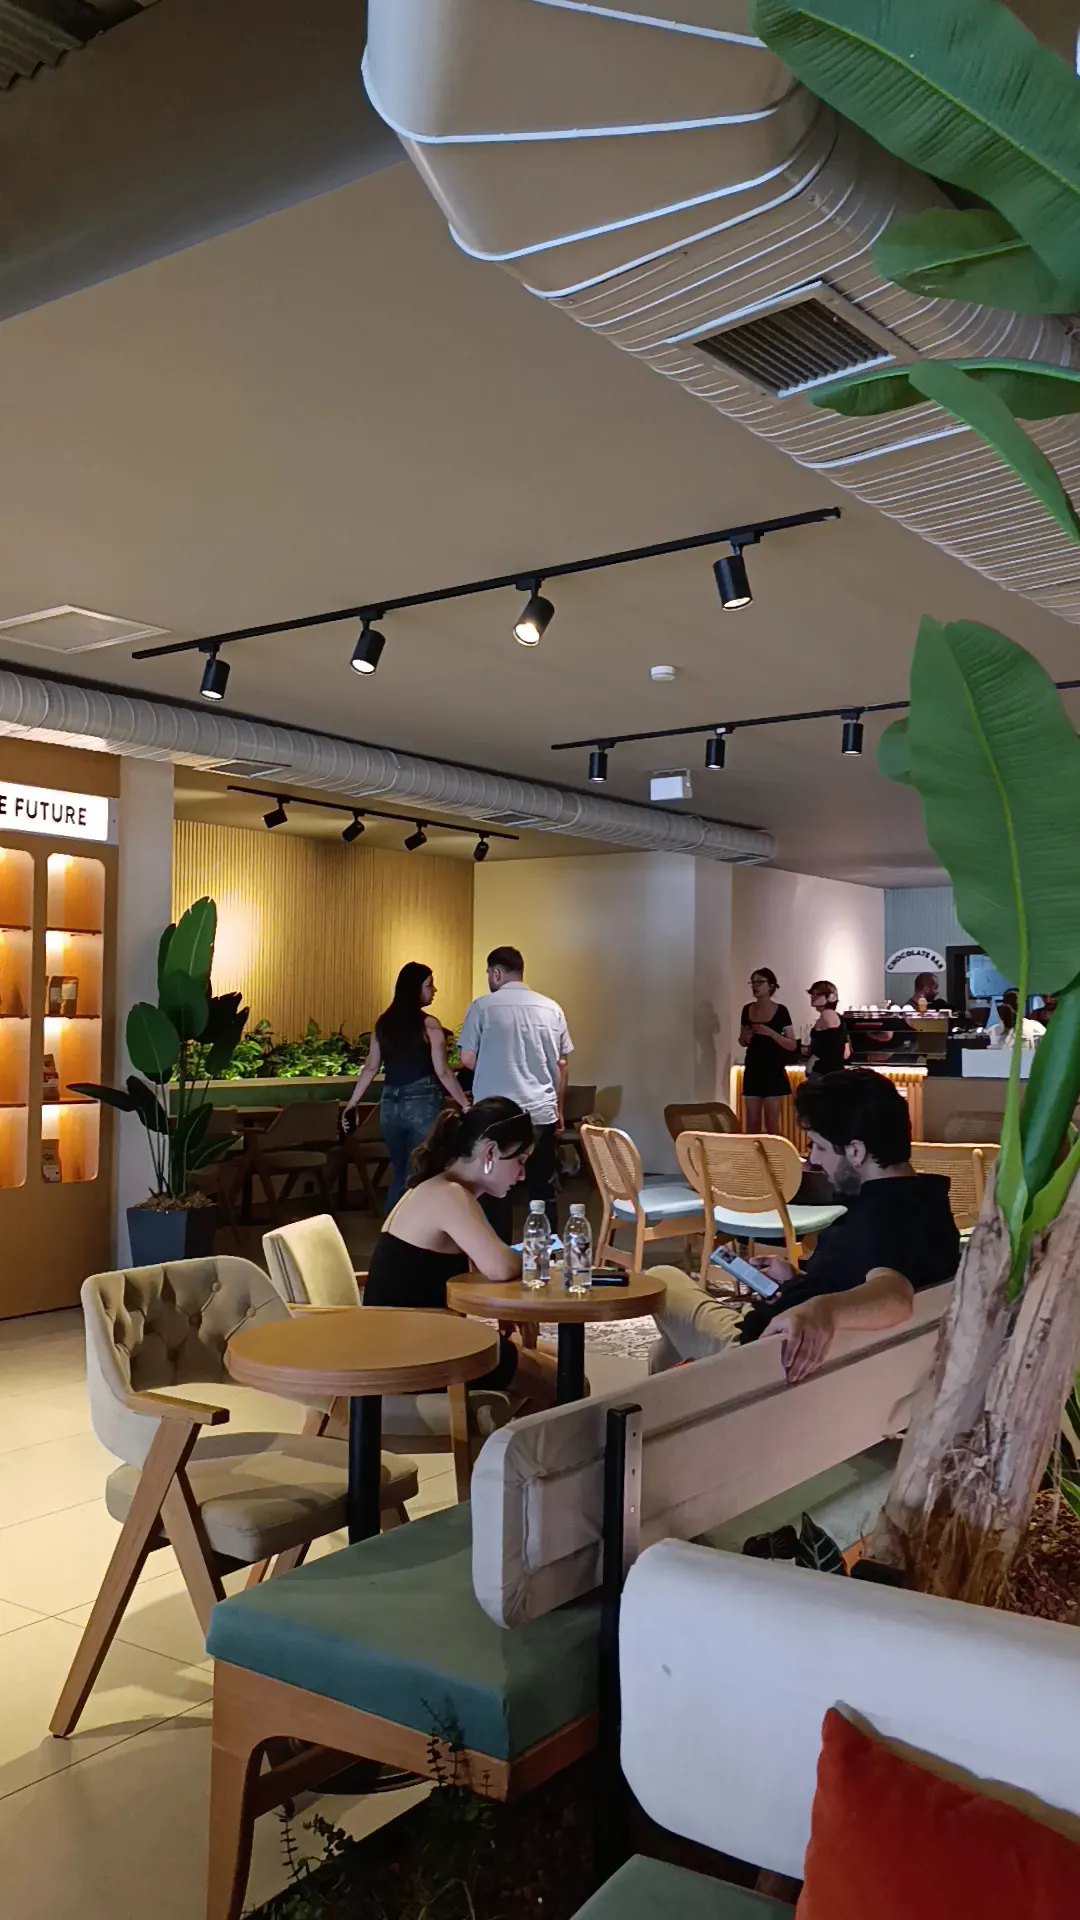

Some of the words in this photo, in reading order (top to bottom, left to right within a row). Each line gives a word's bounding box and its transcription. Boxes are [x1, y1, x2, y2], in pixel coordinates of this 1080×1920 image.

[15, 797, 87, 826] FUTURE
[887, 950, 930, 970] CHOCOLATE
[931, 955, 943, 970] BAR
